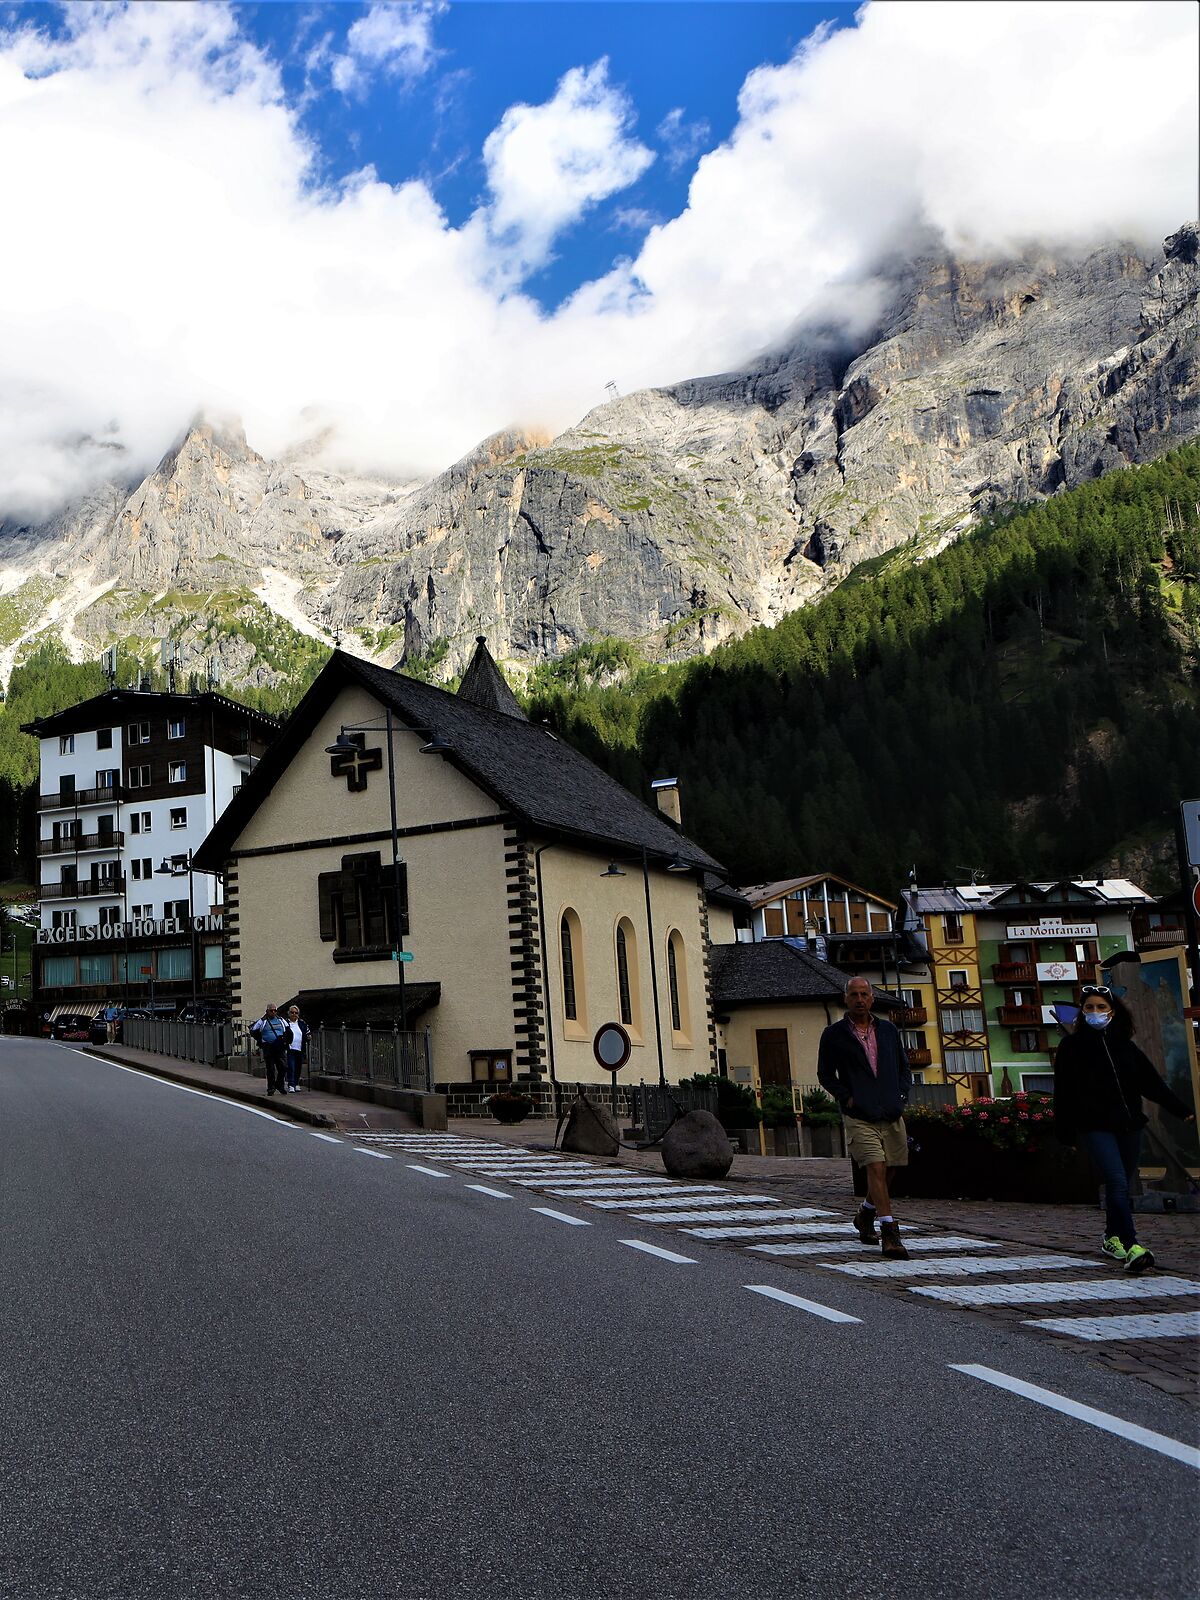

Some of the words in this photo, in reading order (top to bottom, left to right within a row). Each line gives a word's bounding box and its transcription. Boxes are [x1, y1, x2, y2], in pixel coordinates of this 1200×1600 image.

[36, 922, 125, 944] EXCELSIOR
[131, 917, 185, 937] HOTEL
[193, 914, 224, 932] CIM
[1013, 927, 1025, 936] La
[1030, 926, 1092, 935] Montanara
